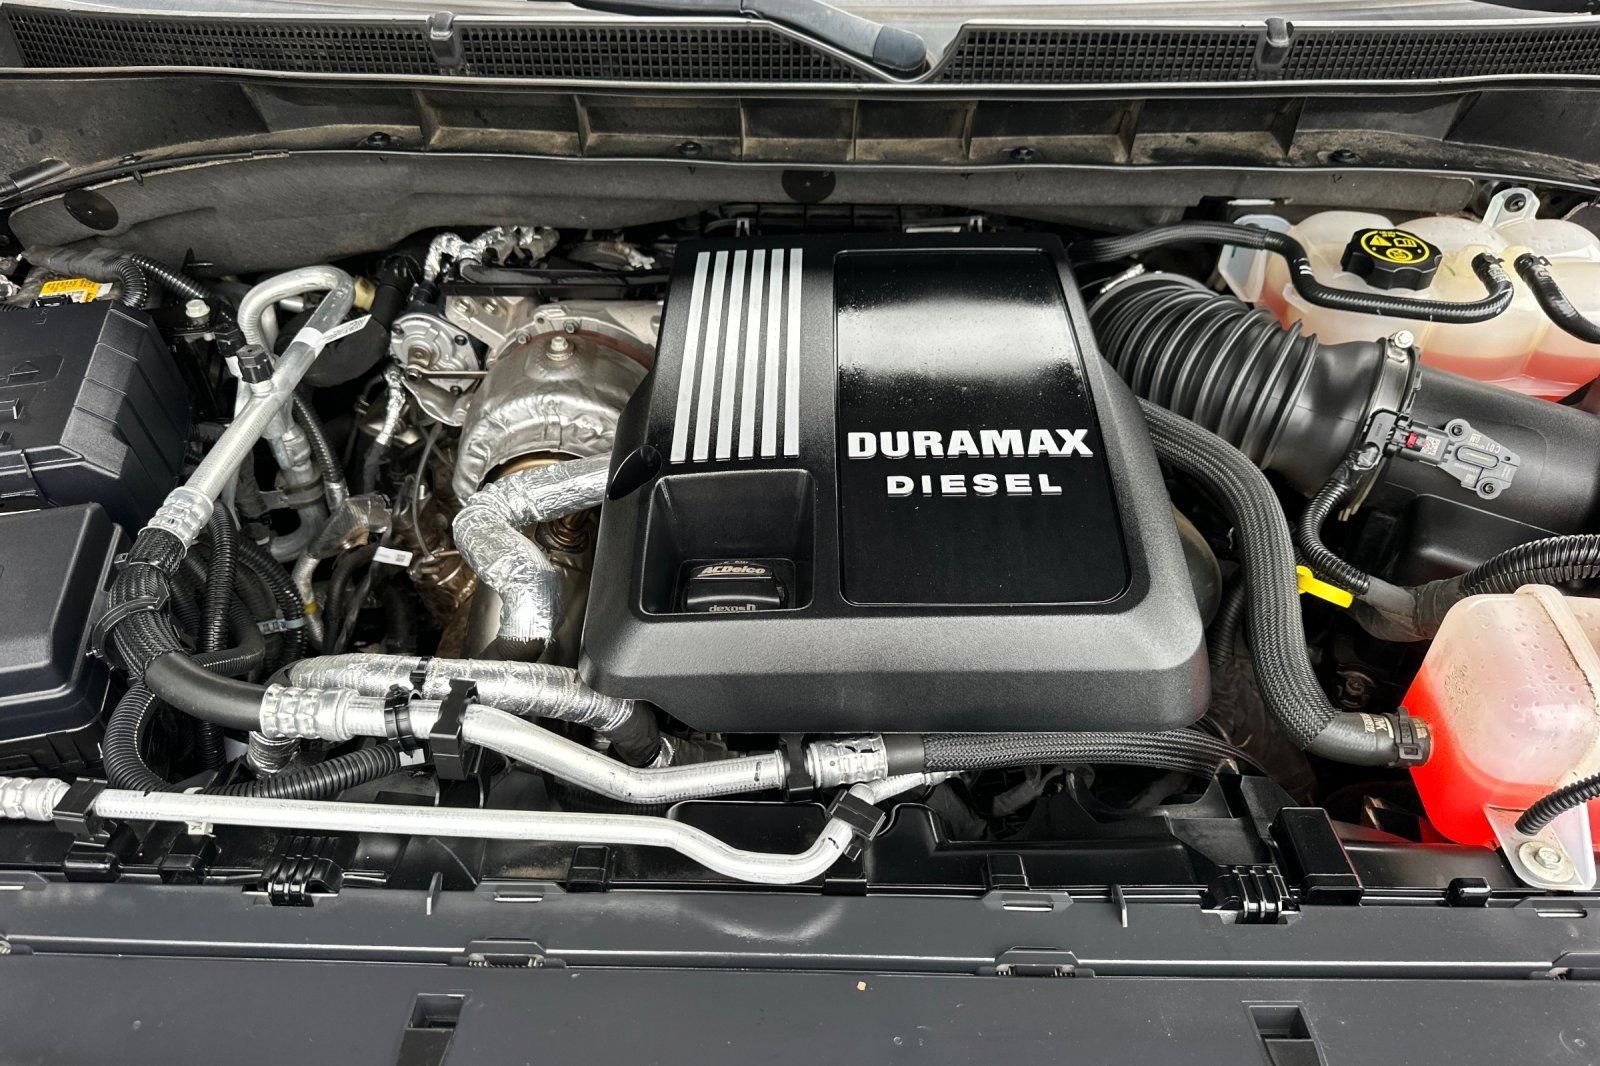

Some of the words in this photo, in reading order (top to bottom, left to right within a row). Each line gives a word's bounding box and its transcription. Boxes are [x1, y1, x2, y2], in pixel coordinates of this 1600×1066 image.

[847, 429, 1093, 459] DURAMAX
[886, 474, 1063, 497] DIESEL
[701, 565, 766, 575] ACDelco
